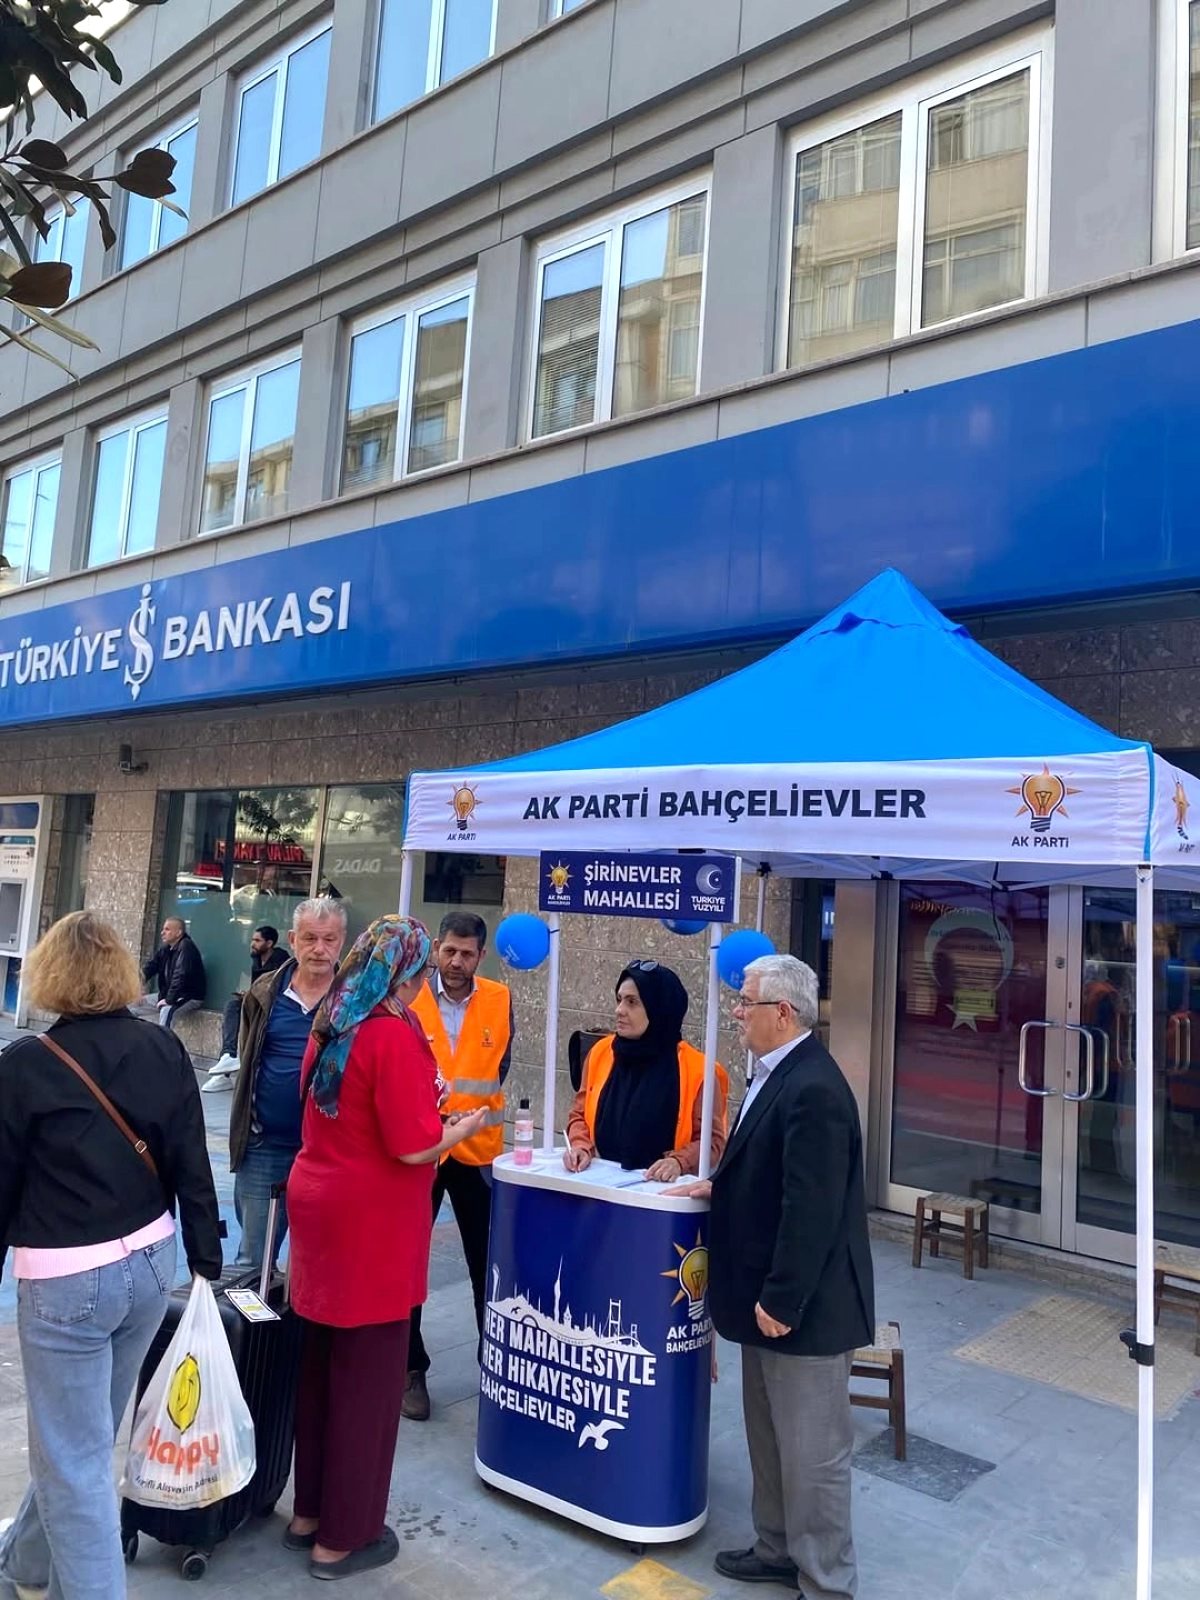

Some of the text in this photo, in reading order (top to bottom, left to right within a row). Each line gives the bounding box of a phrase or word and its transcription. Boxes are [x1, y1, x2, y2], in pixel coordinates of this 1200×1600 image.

[0, 626, 122, 688] TÜRKİYE
[163, 581, 351, 660] BANKASI
[522, 783, 926, 823] AK PARTİ BAHÇELİEVLER
[446, 832, 456, 841] AK
[1011, 836, 1029, 848] AK
[584, 860, 682, 886] ŞİRİNEVLER
[584, 888, 680, 911] MAHALLESİ
[485, 1306, 656, 1385] HER MAHALLESİYLE
[666, 1325, 688, 1340] AK
[482, 1338, 630, 1419] HER HİKAYESİYLE
[481, 1371, 576, 1432] BAHÇELİEVLER
